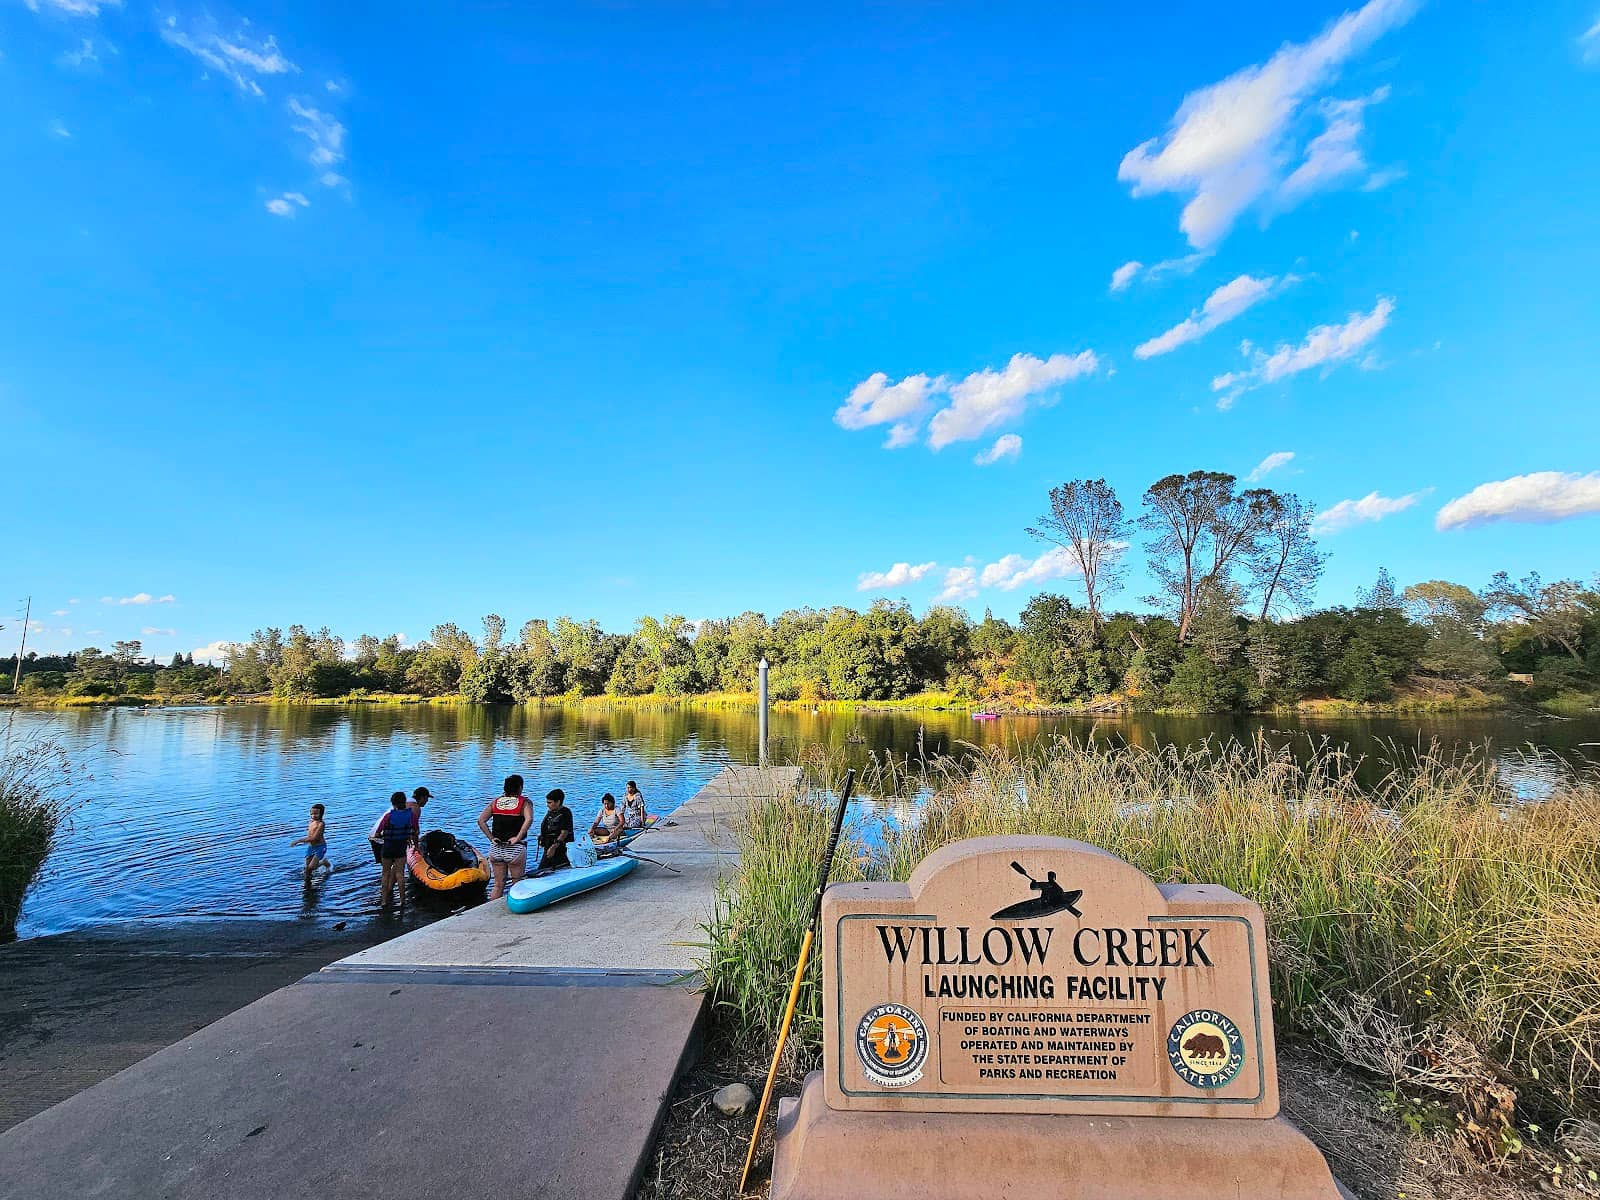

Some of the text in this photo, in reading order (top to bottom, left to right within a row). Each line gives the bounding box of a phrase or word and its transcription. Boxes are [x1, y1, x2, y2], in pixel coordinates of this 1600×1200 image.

[876, 925, 1215, 967] WILLOW CREEK
[924, 974, 1166, 1000] LAUNCHING FACILITY
[942, 1012, 1150, 1024] FUNDED BY CALIFORNIA DEPARTMENT
[964, 1027, 1128, 1037] OF BOATING AND WATERWAYS
[1171, 1011, 1239, 1044] CALIFORNIA
[960, 1040, 1134, 1052] OPERATED AND MAINTAINED BY
[972, 1054, 1126, 1066] THE STATE DEPARTMENT OF
[979, 1068, 1117, 1080] PARKS AND RECREATION
[1170, 1051, 1241, 1086] STATE PARKS
